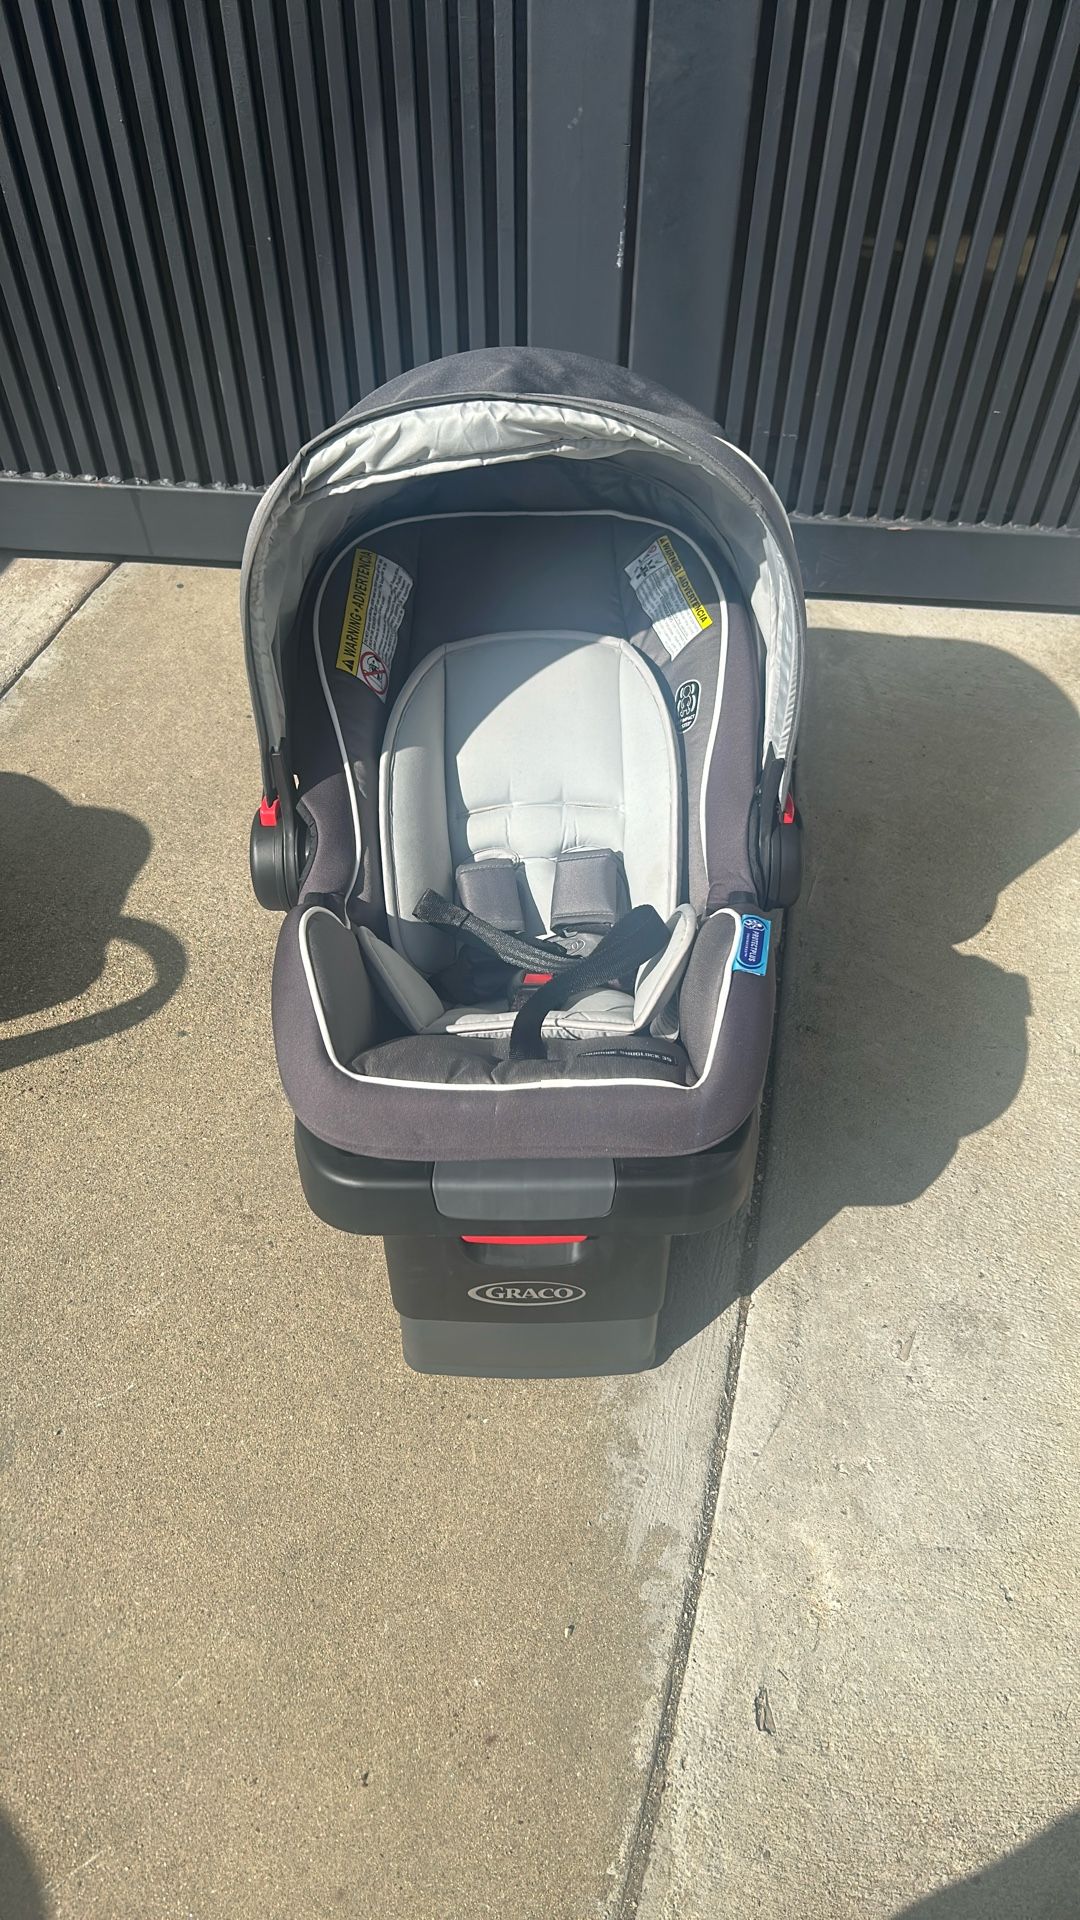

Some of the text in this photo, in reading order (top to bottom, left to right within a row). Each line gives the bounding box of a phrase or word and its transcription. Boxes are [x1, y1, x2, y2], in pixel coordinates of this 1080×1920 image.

[344, 551, 373, 661] WARNING ADVERTENCIA
[485, 1286, 574, 1299] GRACO
